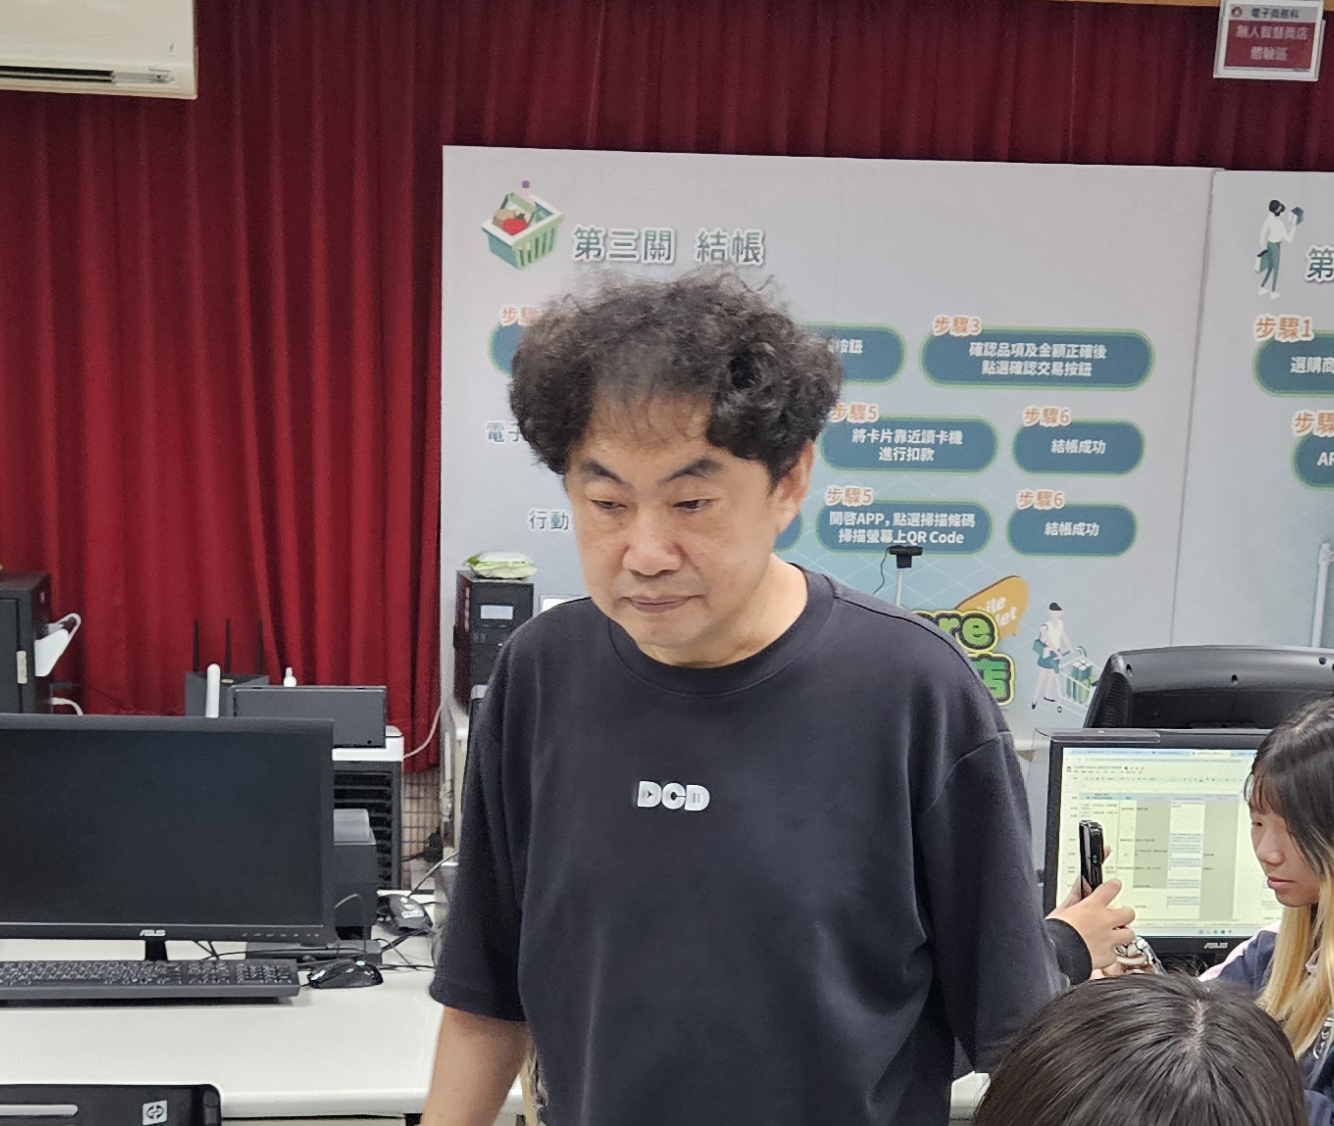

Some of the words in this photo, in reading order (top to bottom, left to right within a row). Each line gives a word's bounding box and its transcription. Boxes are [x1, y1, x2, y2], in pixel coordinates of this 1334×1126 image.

[572, 227, 673, 262] 第三關
[695, 229, 766, 264] 結帳
[934, 316, 982, 336] 步驟3
[1255, 317, 1312, 341] 步驟1
[830, 404, 879, 423] 步驟5
[1024, 407, 1071, 426] 步驟6
[878, 447, 935, 462] 進行扣款
[1051, 438, 1107, 455] 結帳成功
[826, 487, 874, 506] 步驟5
[1018, 490, 1064, 508] 步驟6
[528, 510, 575, 530] 行動
[1044, 521, 1100, 538] 結帳成功
[929, 530, 965, 544] Code
[637, 780, 710, 812] DCD
